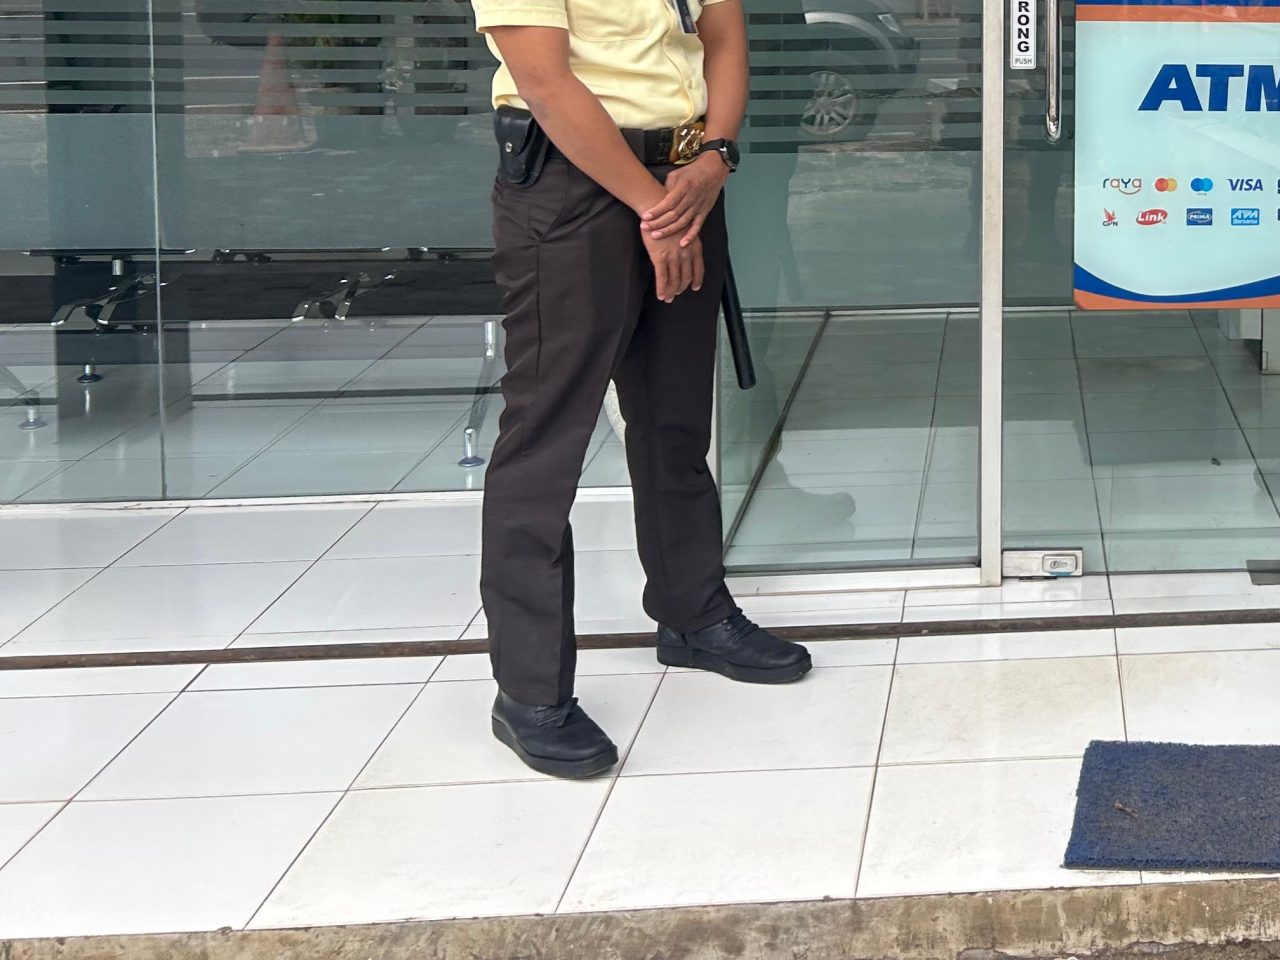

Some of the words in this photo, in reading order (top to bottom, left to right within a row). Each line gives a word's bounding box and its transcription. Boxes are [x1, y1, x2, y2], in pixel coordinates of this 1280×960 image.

[1227, 178, 1263, 191] VISA
[1137, 211, 1165, 223] Link
[1232, 209, 1258, 219] ATM
